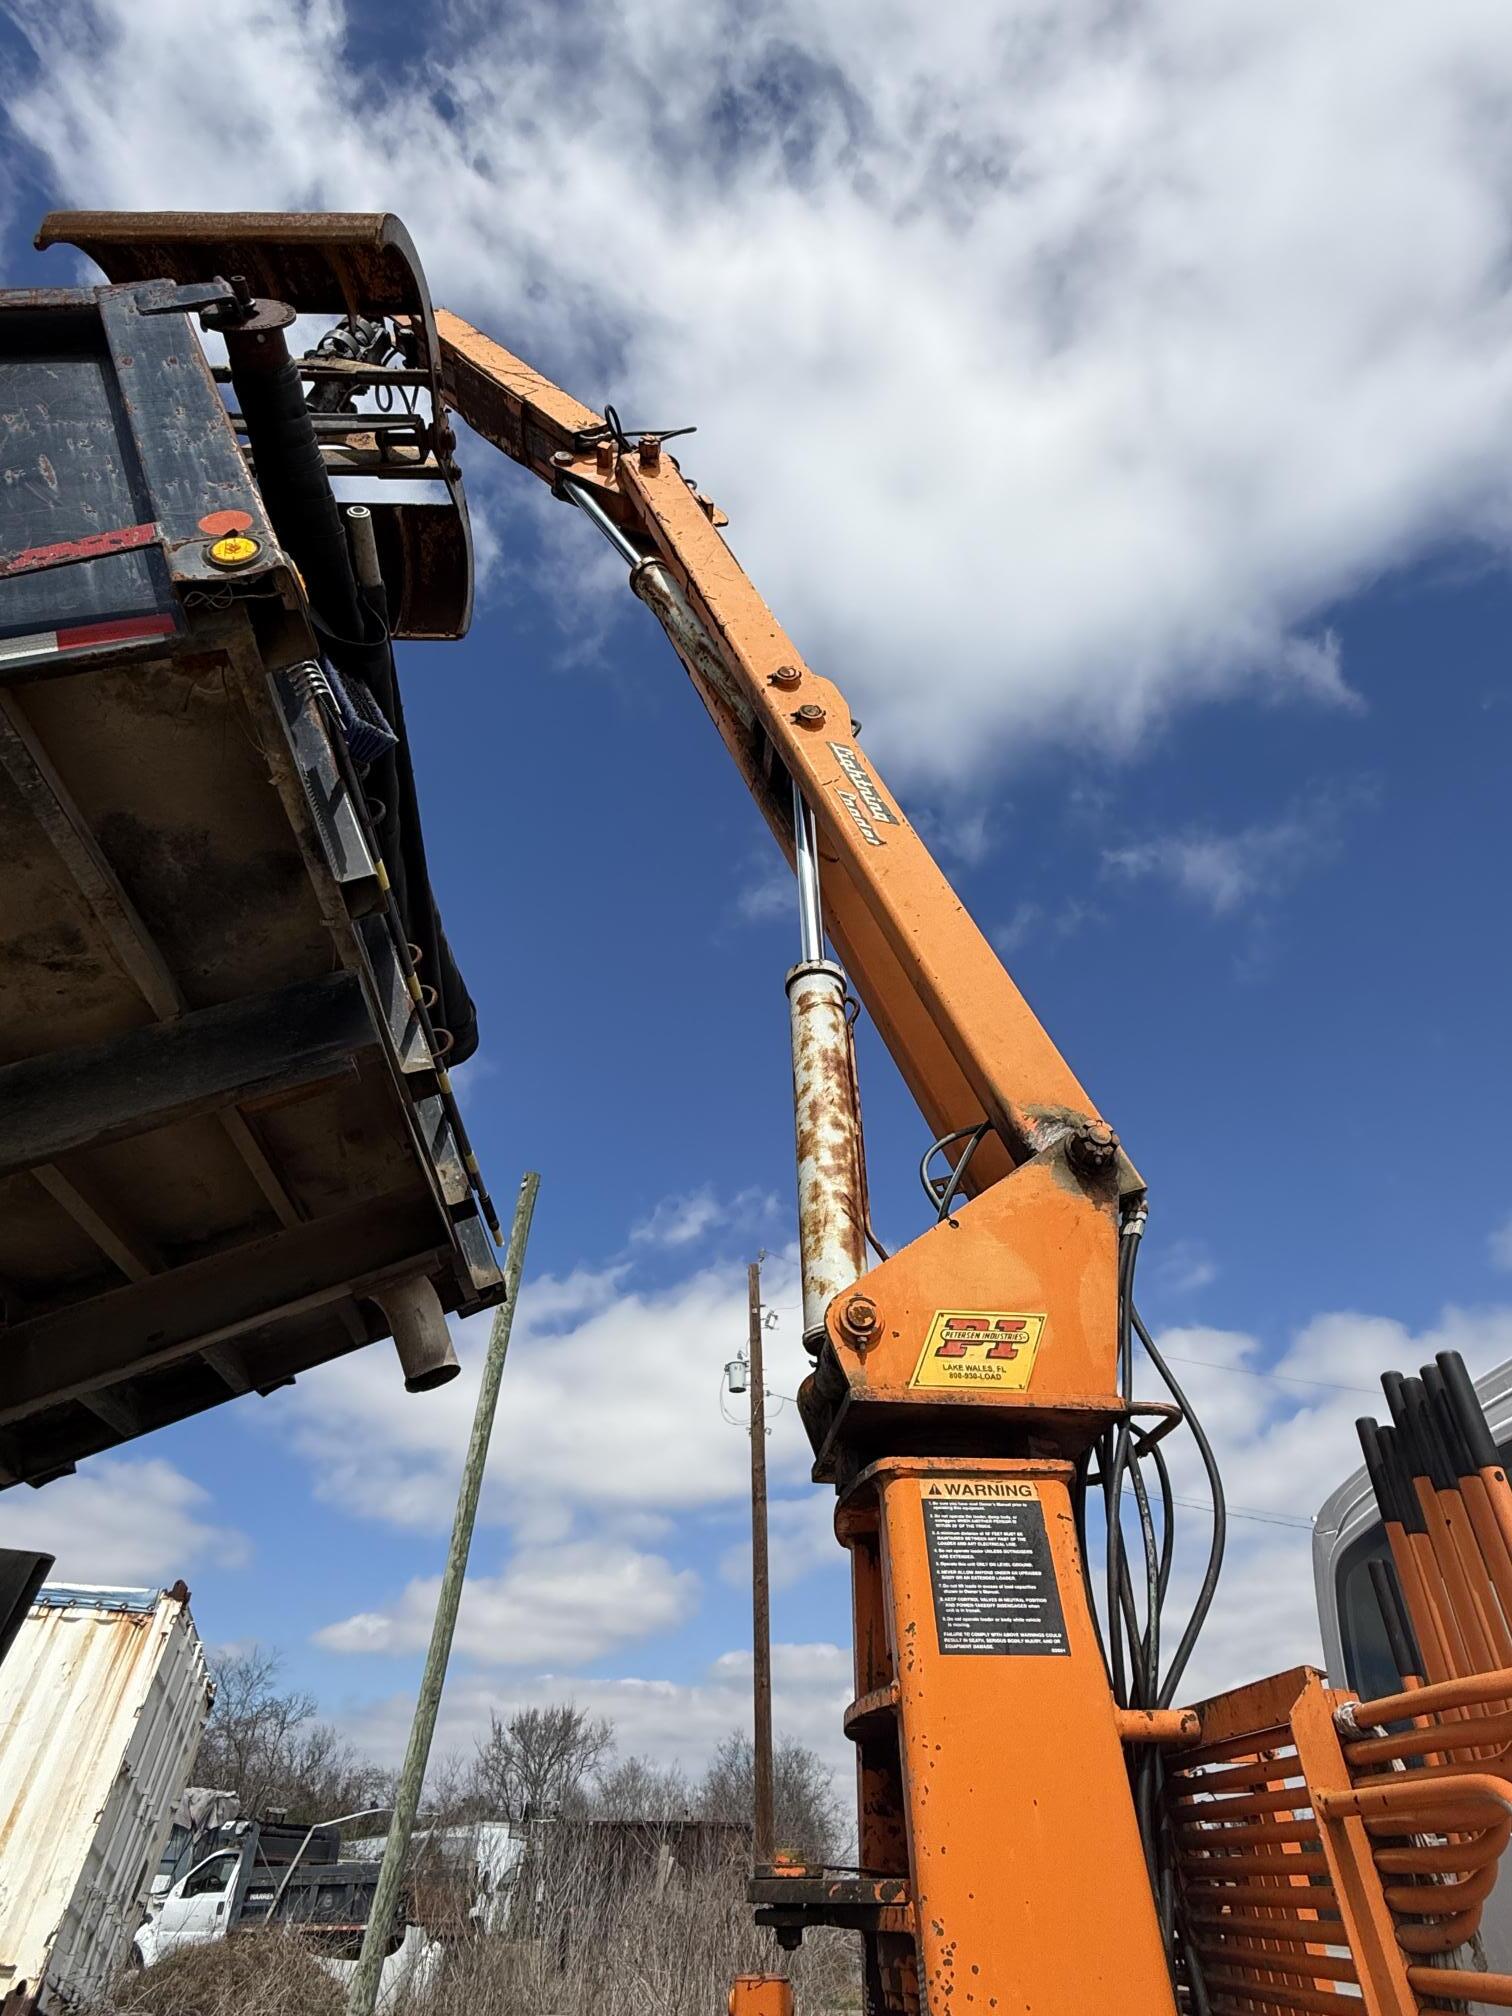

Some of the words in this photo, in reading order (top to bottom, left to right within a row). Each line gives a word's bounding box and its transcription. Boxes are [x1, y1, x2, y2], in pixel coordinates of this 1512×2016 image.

[830, 742, 890, 822] Lightning
[945, 1330, 980, 1339] PETERSEN
[982, 1331, 1022, 1340] INDUSTRIES
[944, 1483, 1032, 1496] WARNING
